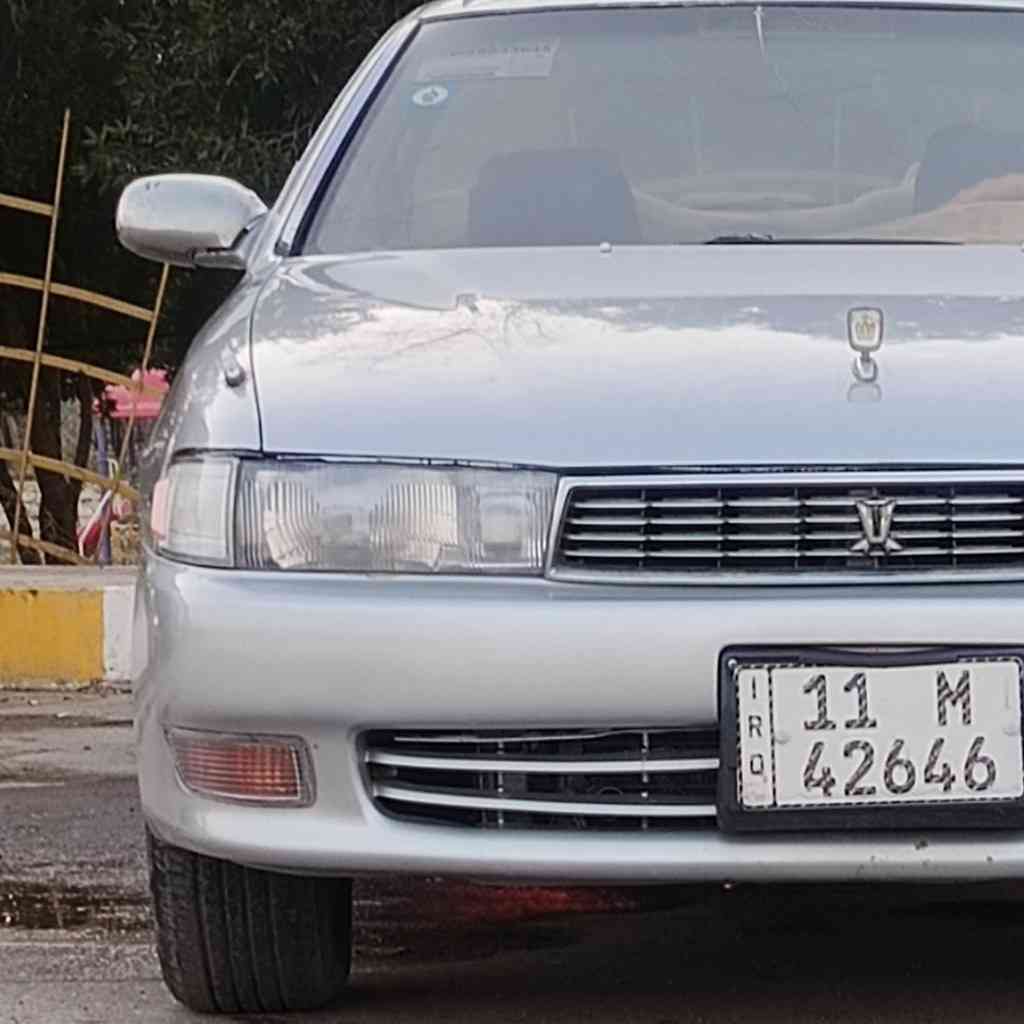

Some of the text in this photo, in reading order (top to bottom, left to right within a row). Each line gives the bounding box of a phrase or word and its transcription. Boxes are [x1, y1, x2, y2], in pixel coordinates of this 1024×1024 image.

[803, 670, 972, 730] 11 M
[803, 736, 997, 797] 42646
